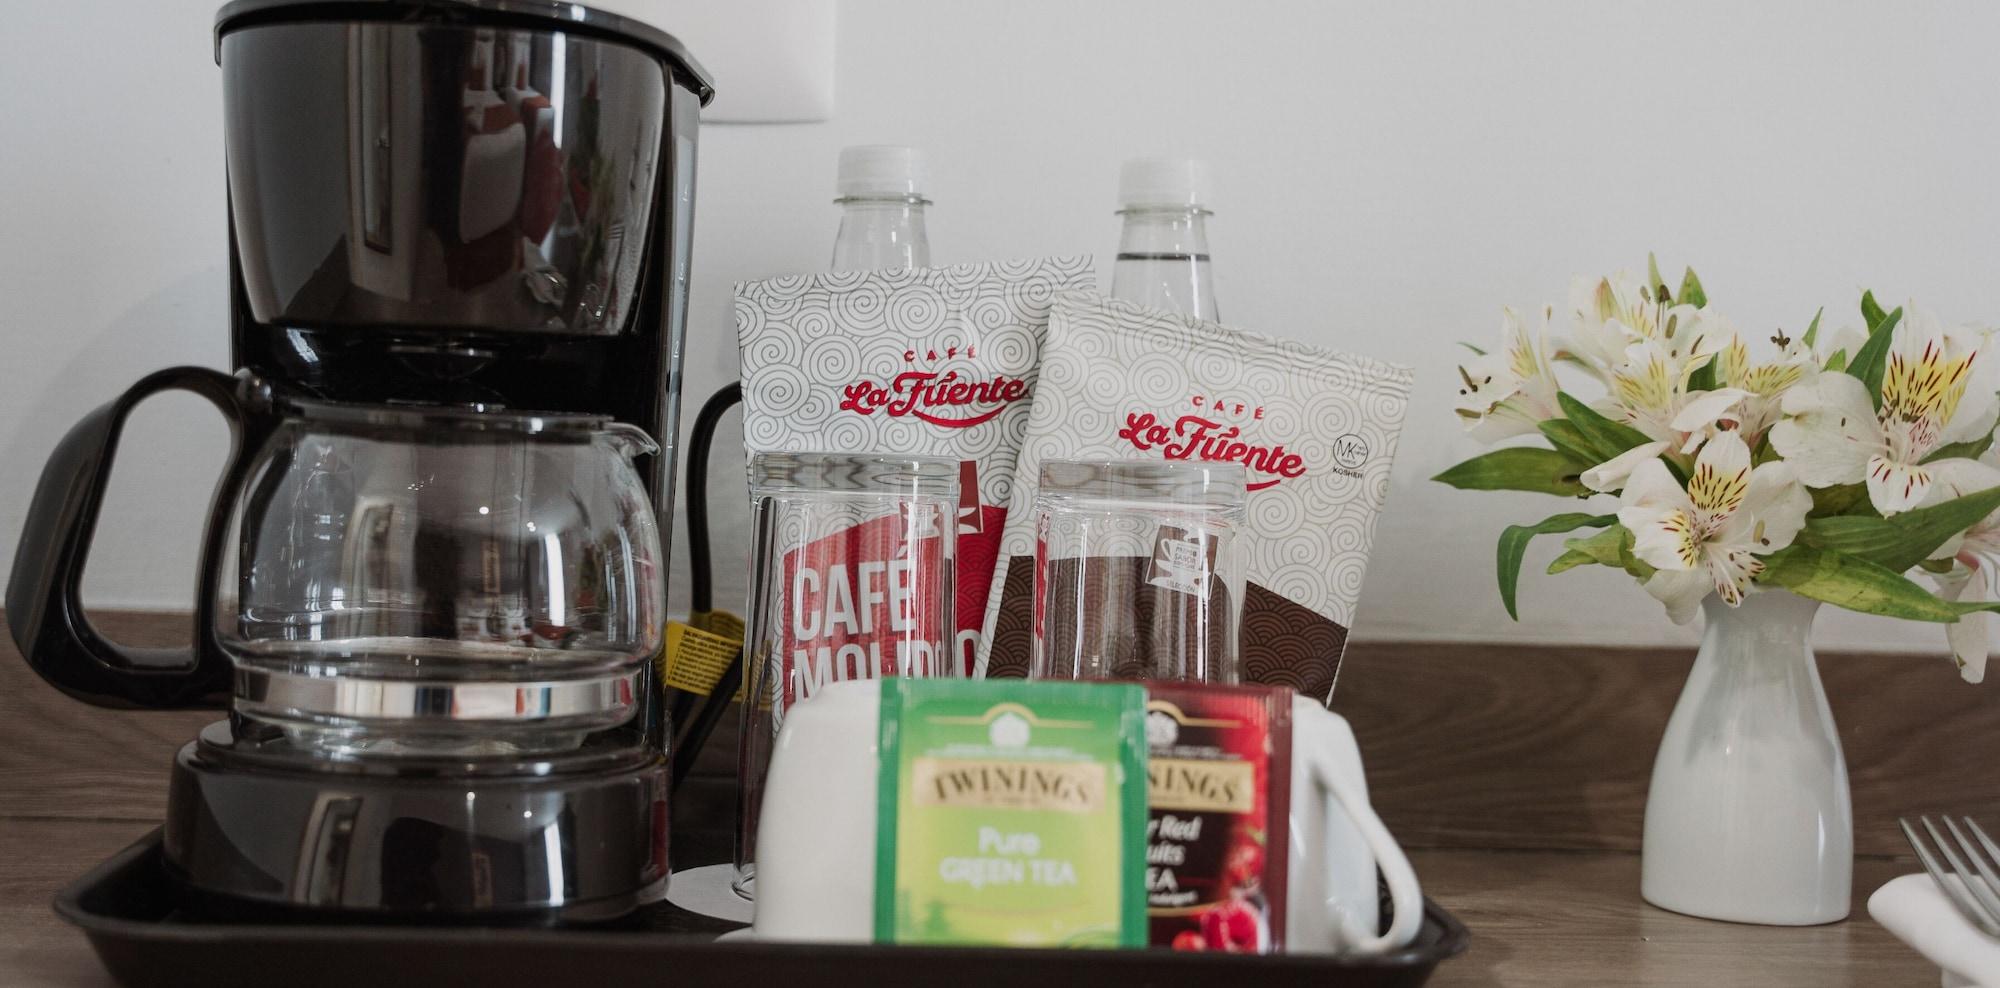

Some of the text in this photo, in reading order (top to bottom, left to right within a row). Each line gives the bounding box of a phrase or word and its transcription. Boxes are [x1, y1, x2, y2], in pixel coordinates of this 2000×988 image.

[903, 343, 976, 362] CAFÉ
[839, 380, 891, 415] La
[1191, 395, 1264, 420] CAFÉ
[1119, 412, 1171, 450] La
[1332, 466, 1363, 480] KOSHER
[793, 541, 918, 641] CAFÉ
[934, 765, 1089, 803] TWININGS
[977, 825, 1041, 856] Pure
[1159, 814, 1203, 842] Red
[939, 855, 1078, 888] GREEN TEA
